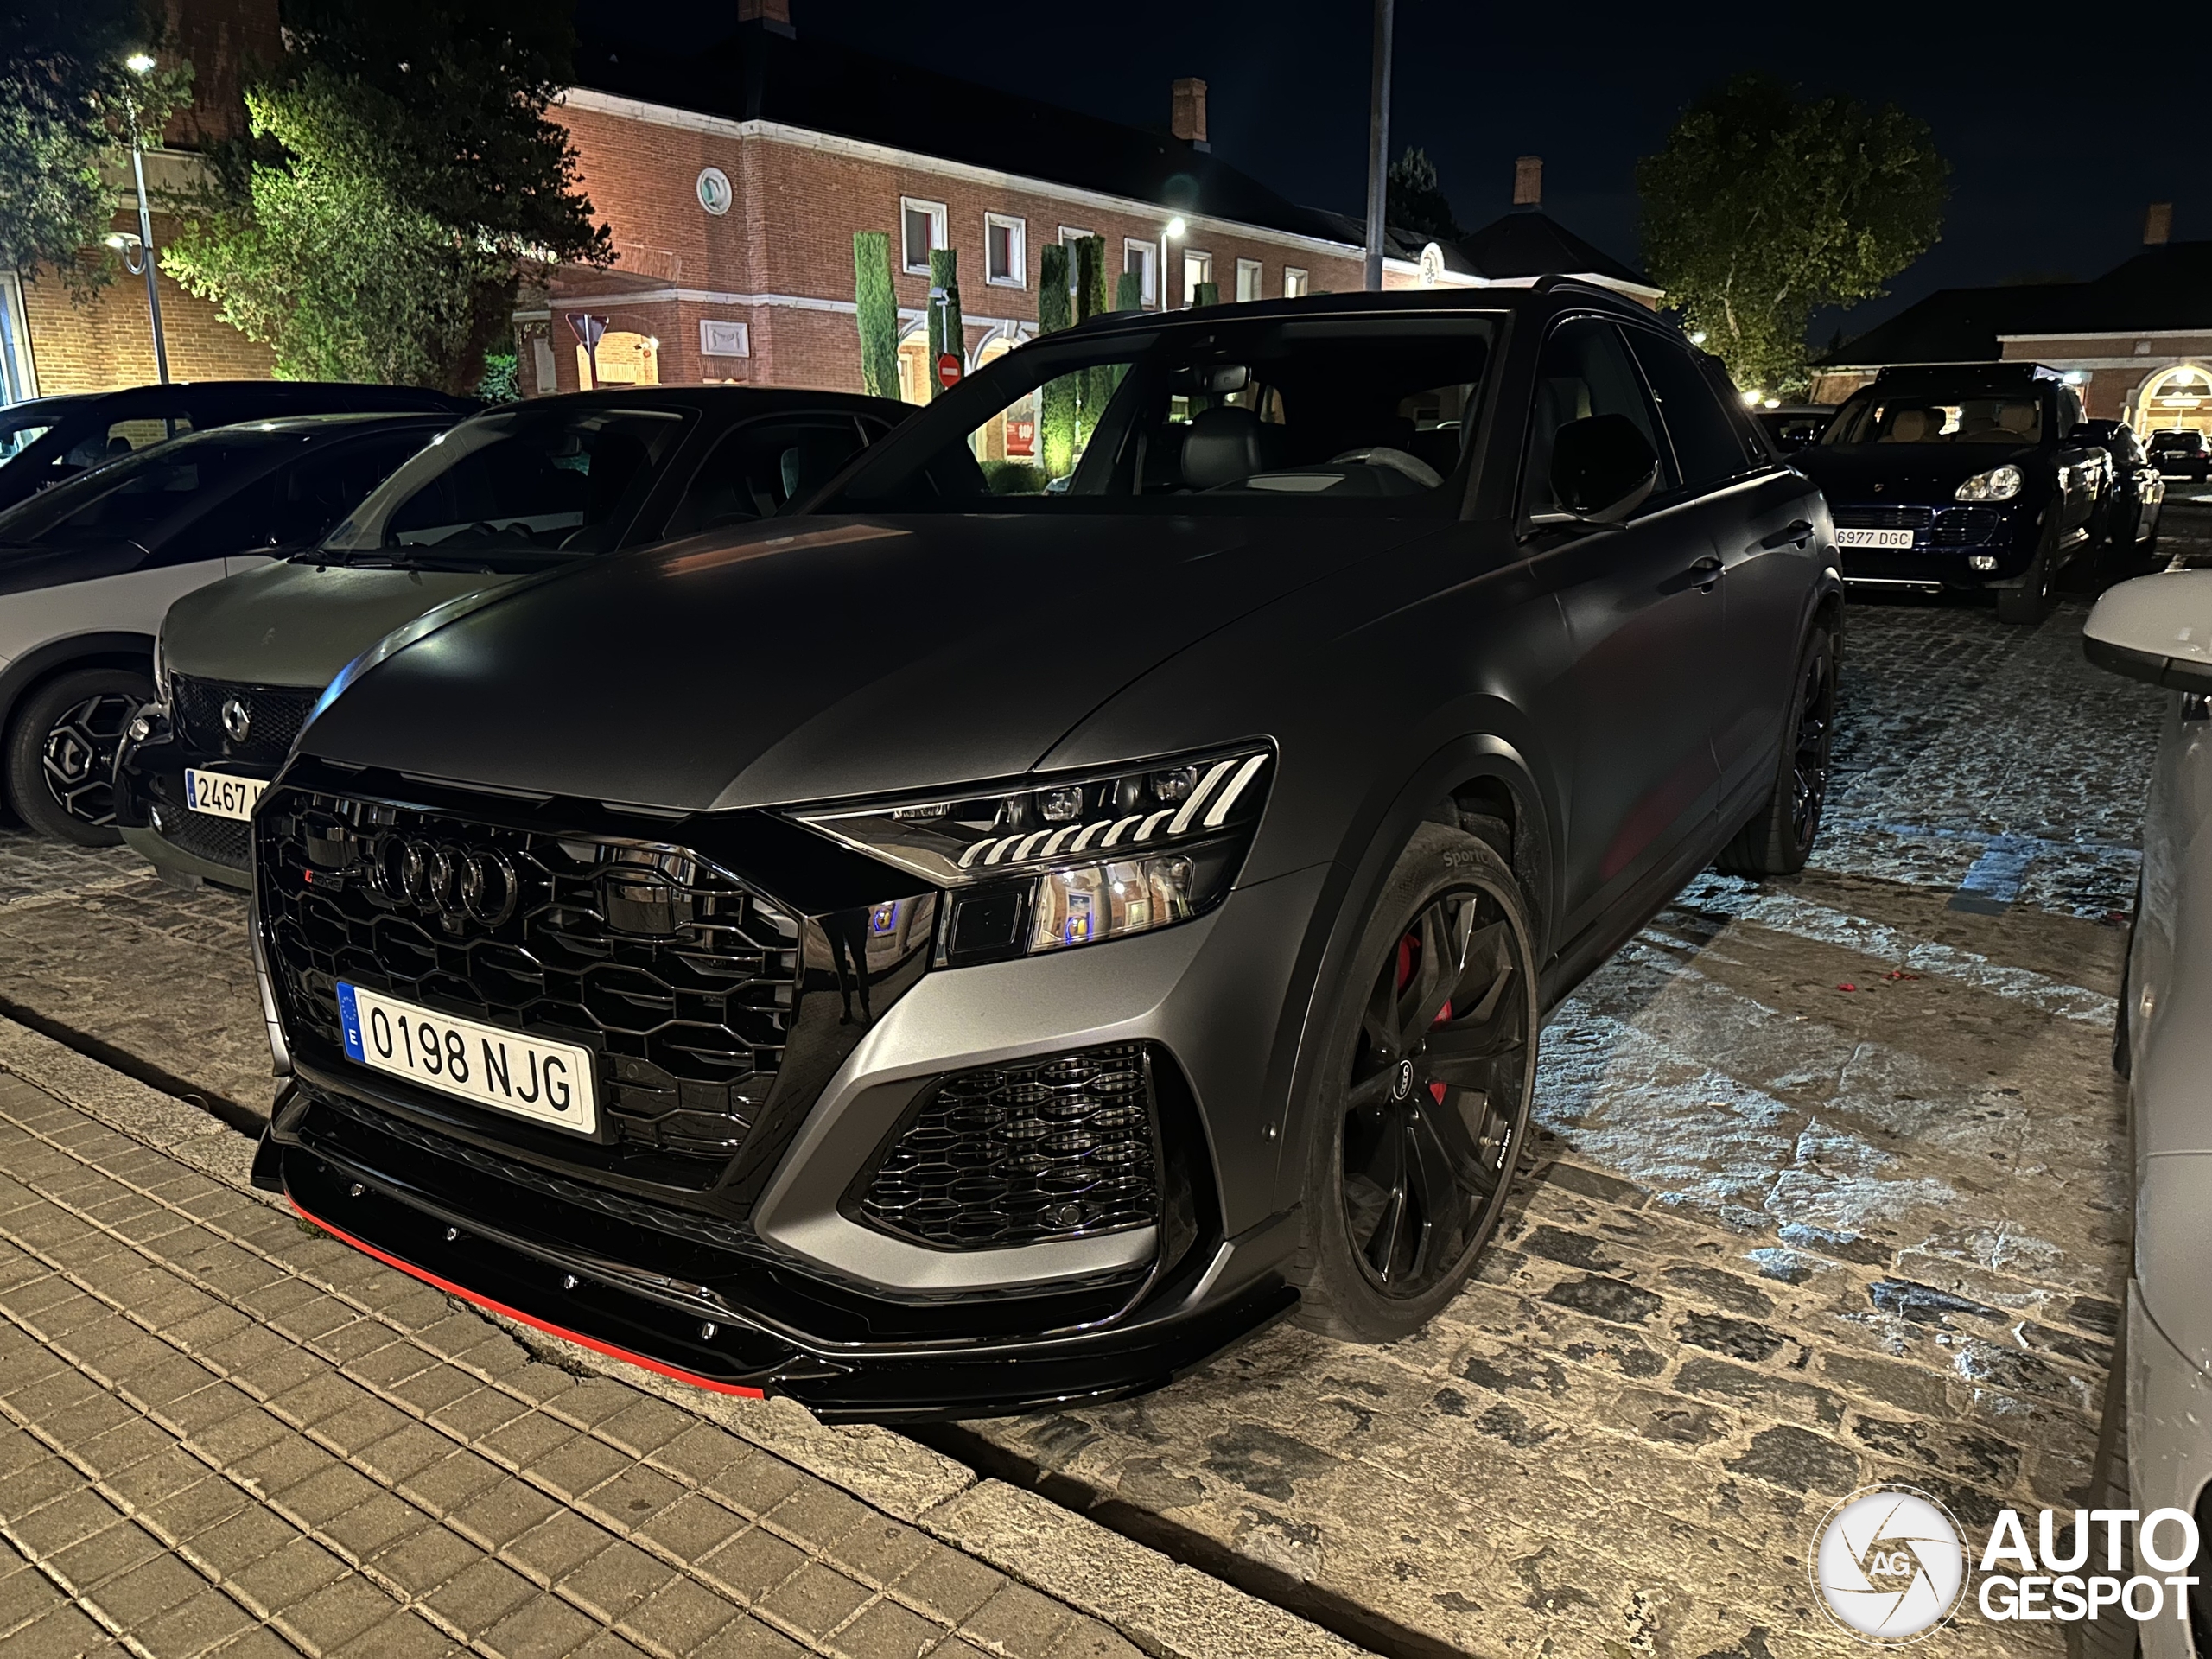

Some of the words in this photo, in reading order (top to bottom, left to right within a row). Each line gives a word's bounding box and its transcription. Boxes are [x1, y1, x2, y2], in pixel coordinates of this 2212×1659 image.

[1837, 531, 1874, 544] 6977
[1879, 532, 1909, 545] DGC
[198, 777, 245, 814] 2467
[348, 1028, 359, 1046] E
[371, 1007, 469, 1084] 0198
[481, 1038, 570, 1112] NJG
